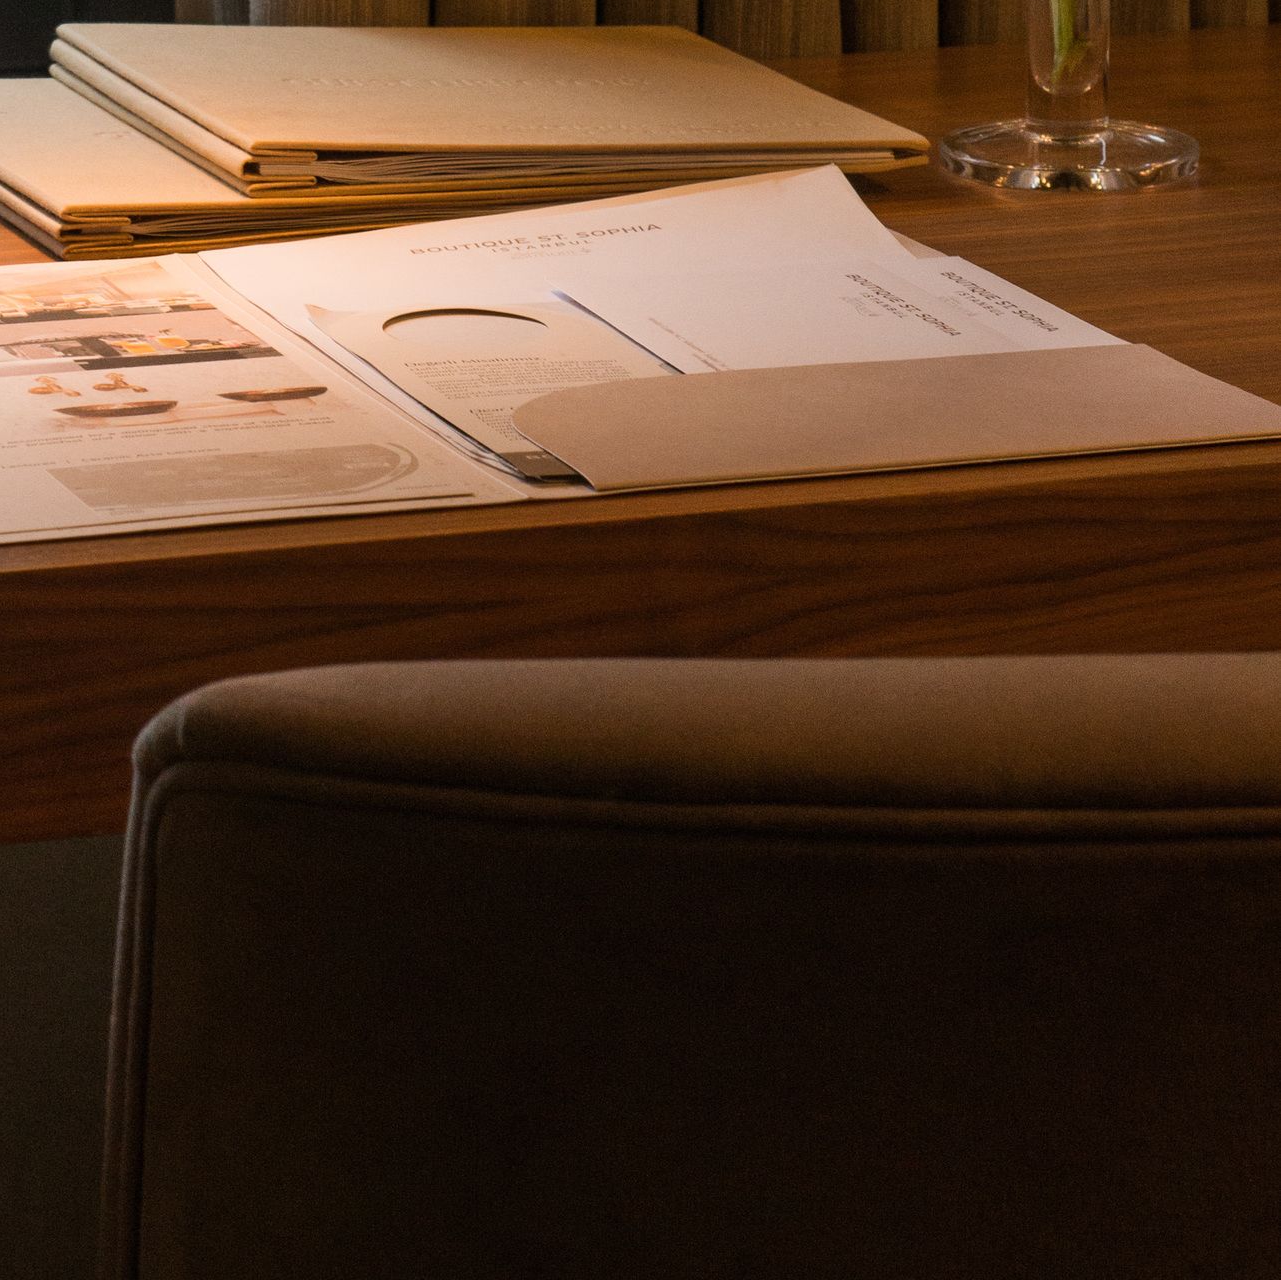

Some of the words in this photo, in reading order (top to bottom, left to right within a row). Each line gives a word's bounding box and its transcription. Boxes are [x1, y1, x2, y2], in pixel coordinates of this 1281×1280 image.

[410, 237, 531, 255] BOUTIQUE
[576, 224, 662, 239] SOPHIA
[492, 240, 593, 253] ISTANBUL
[845, 274, 905, 303] BOUTIQUE
[915, 313, 962, 336] SOPHIA
[940, 271, 1002, 300] BOUTIQUE
[1011, 309, 1059, 332] SOPHIA
